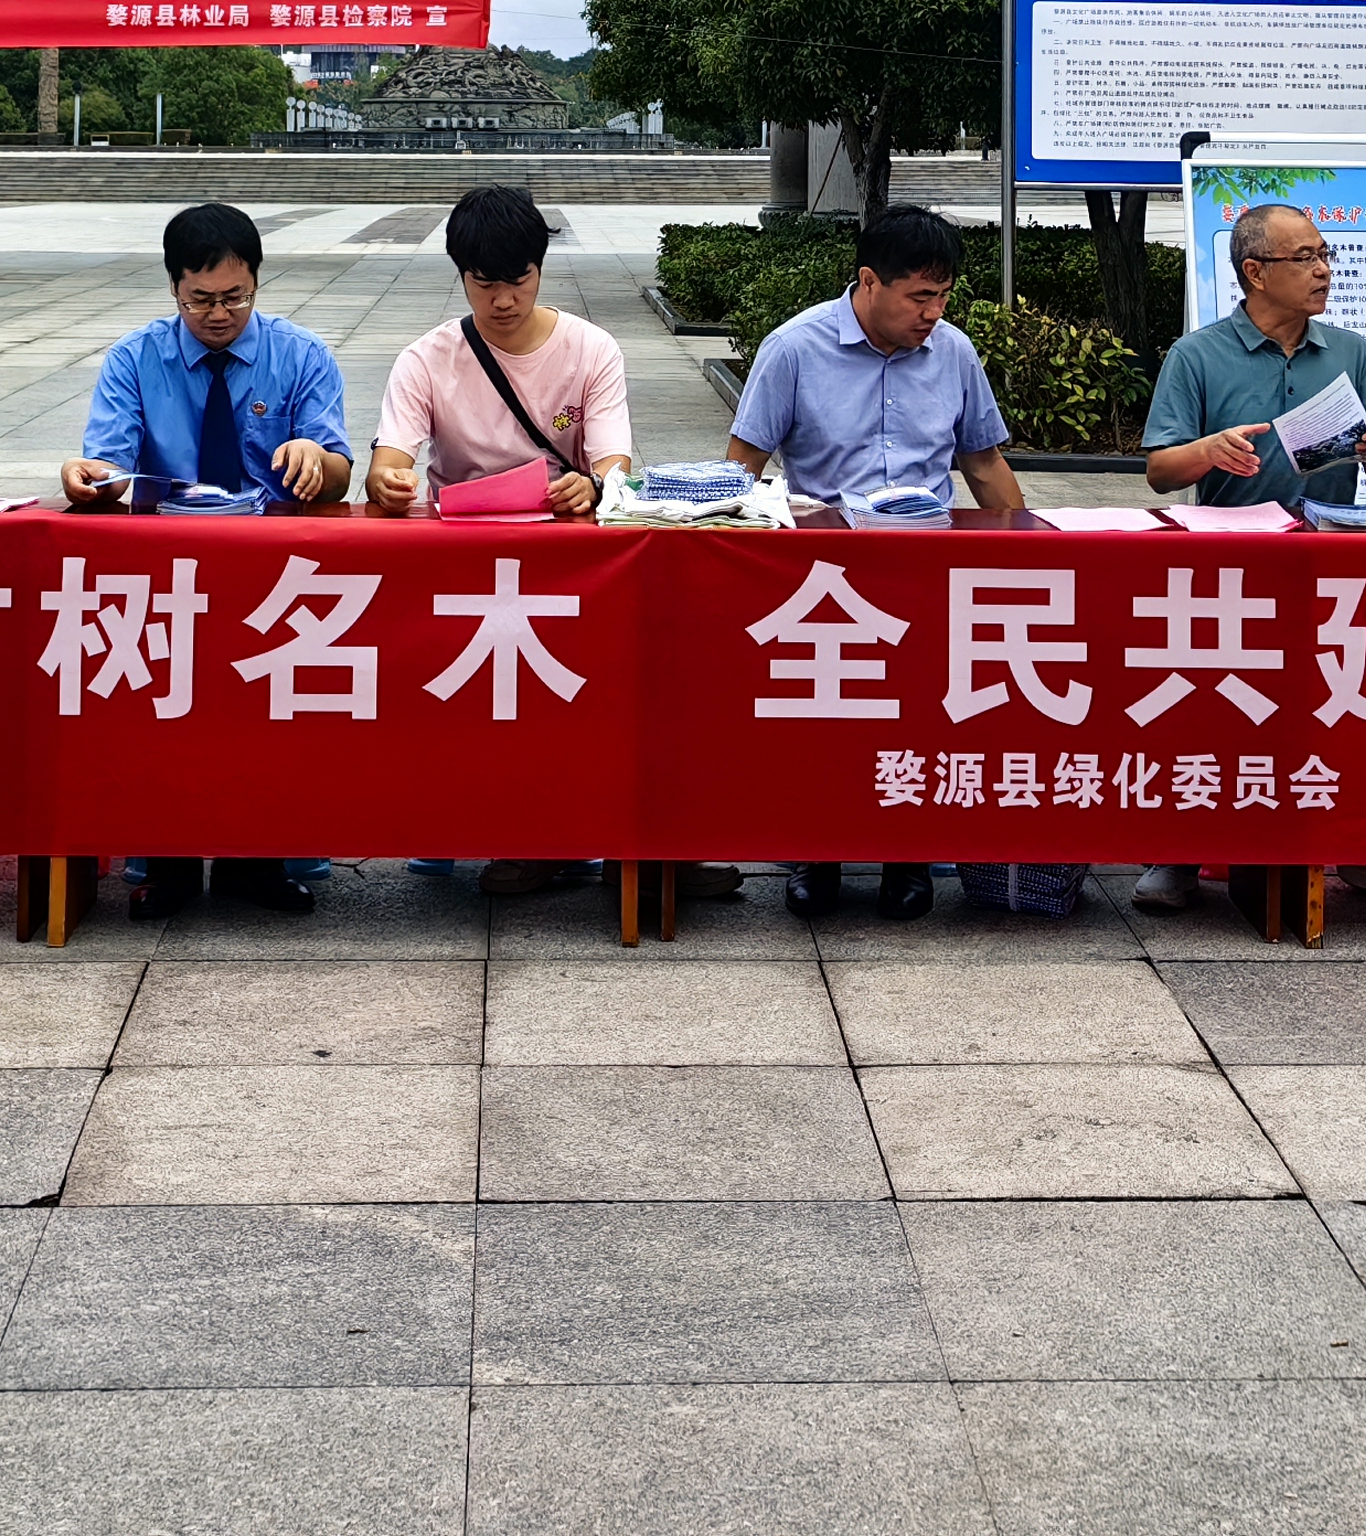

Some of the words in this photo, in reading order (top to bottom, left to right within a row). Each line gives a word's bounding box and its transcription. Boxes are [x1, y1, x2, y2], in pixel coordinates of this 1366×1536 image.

[106, 3, 249, 28] 婺源县林业局
[269, 4, 413, 28] 婺源县检察院
[425, 5, 448, 27] 宣
[874, 749, 1341, 811] 婺源县绿化委员会
